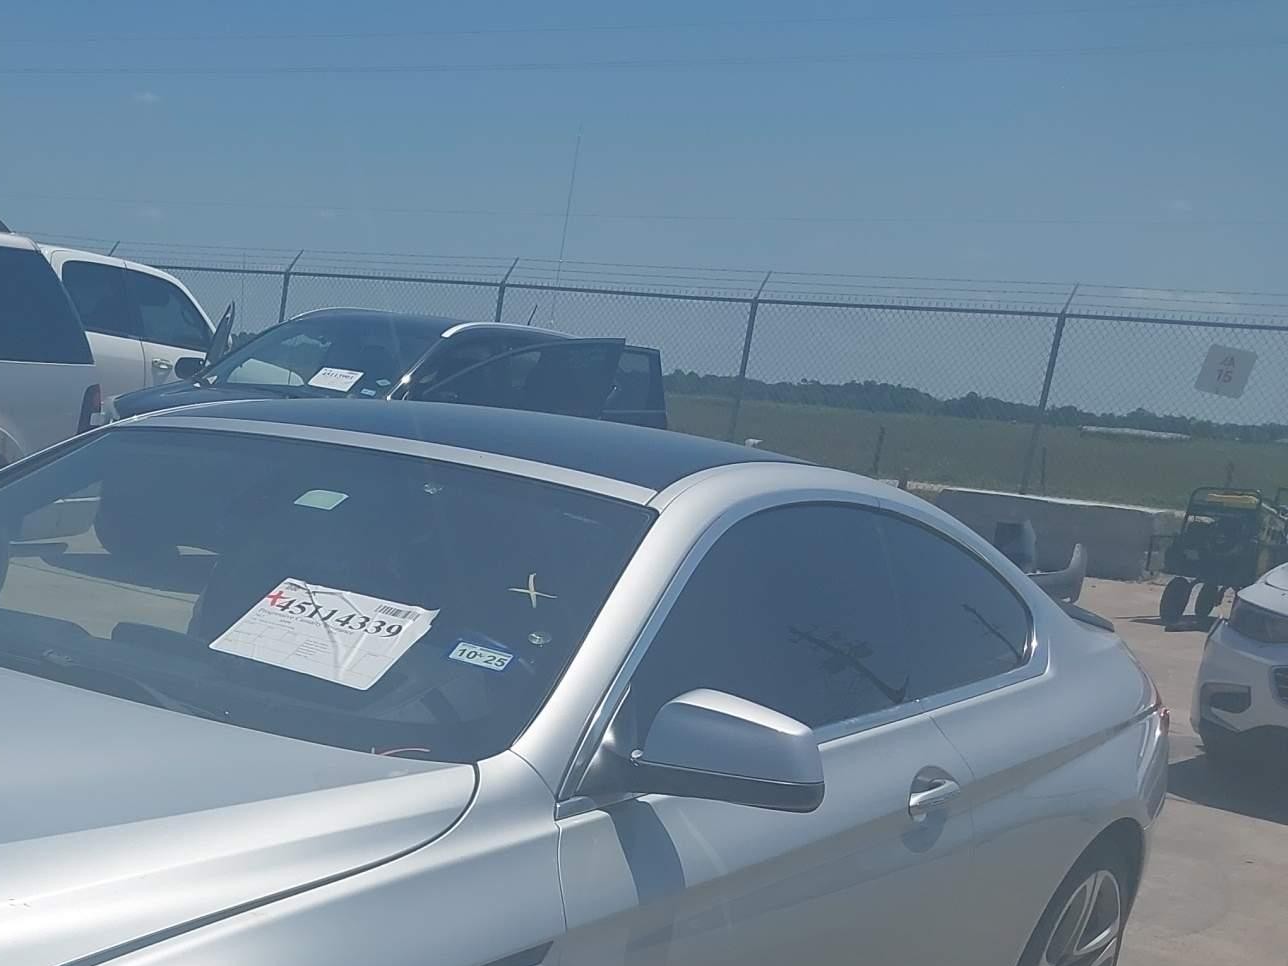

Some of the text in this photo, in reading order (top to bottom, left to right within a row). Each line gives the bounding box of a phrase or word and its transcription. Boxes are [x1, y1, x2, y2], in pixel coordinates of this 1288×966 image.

[276, 598, 403, 638] 45114339
[457, 648, 509, 667] 10 25
